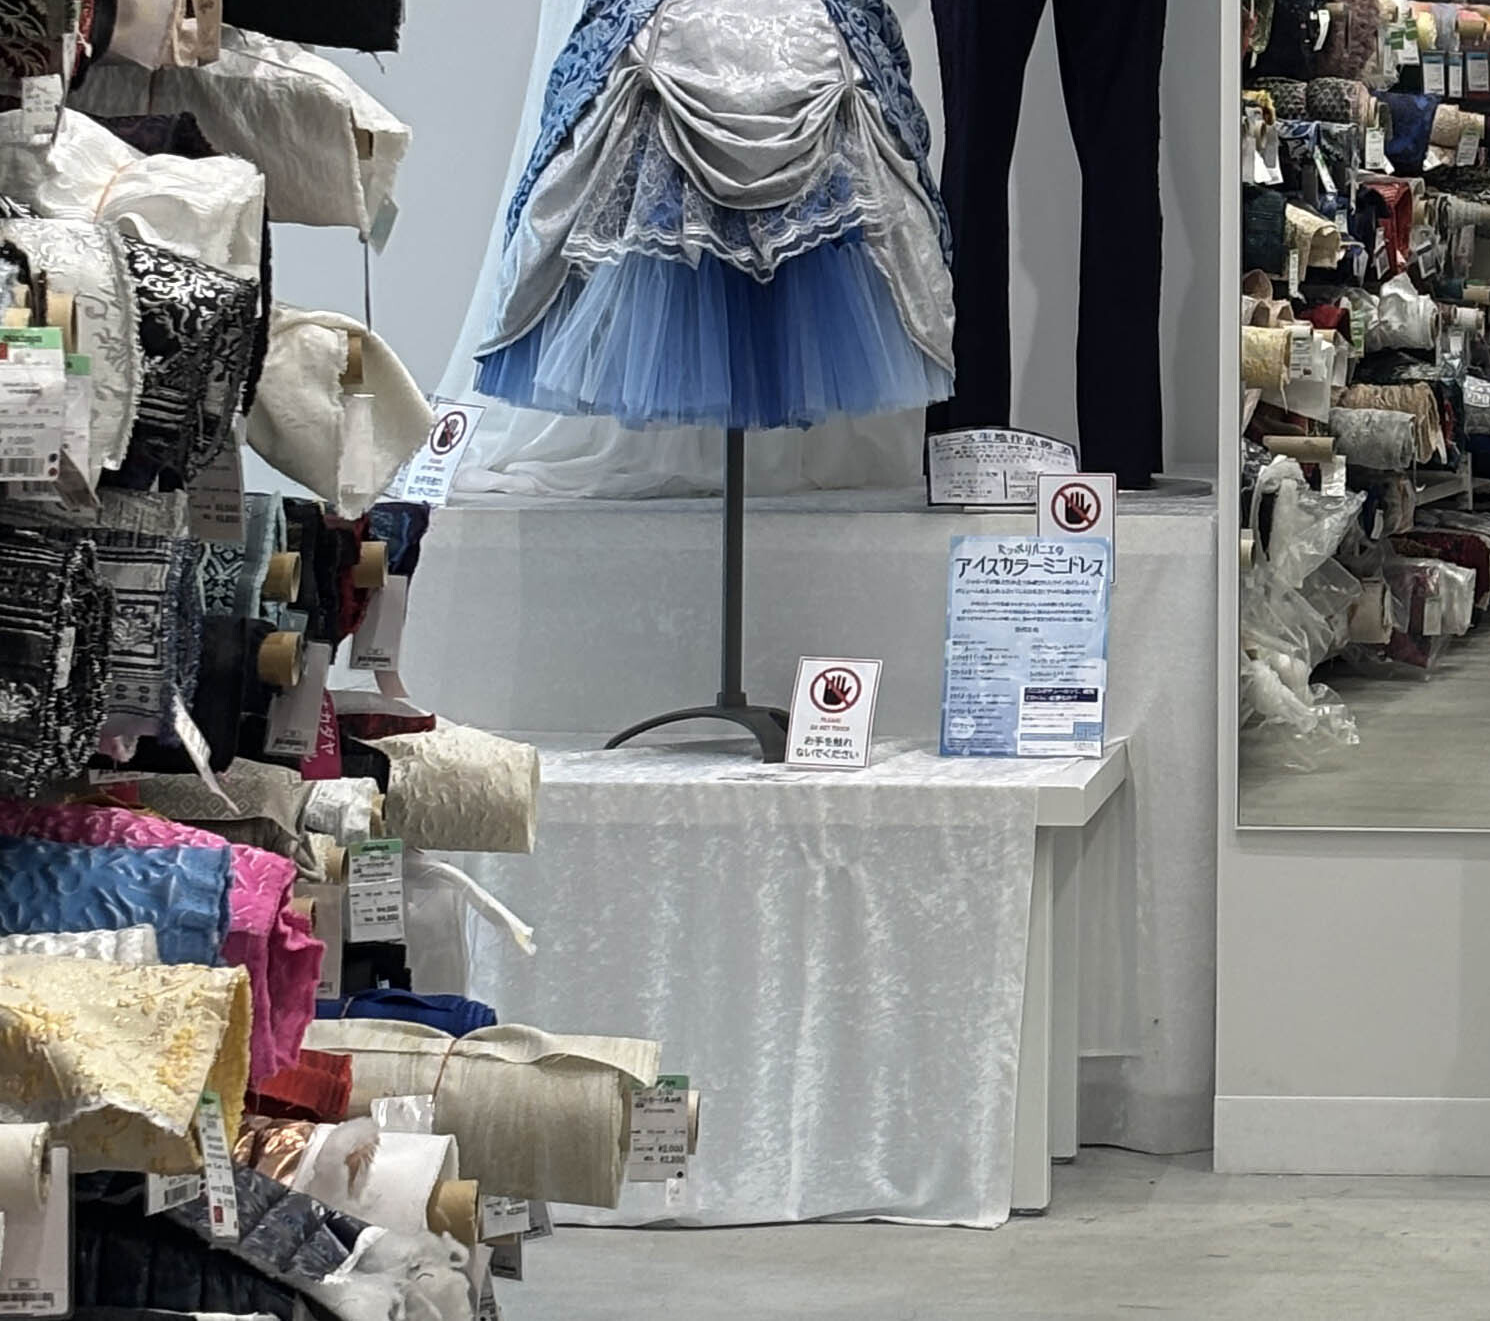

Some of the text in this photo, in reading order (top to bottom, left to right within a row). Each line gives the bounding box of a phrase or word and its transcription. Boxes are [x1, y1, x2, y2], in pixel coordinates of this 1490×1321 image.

[955, 556, 1105, 578] アイスカラーミニドレス
